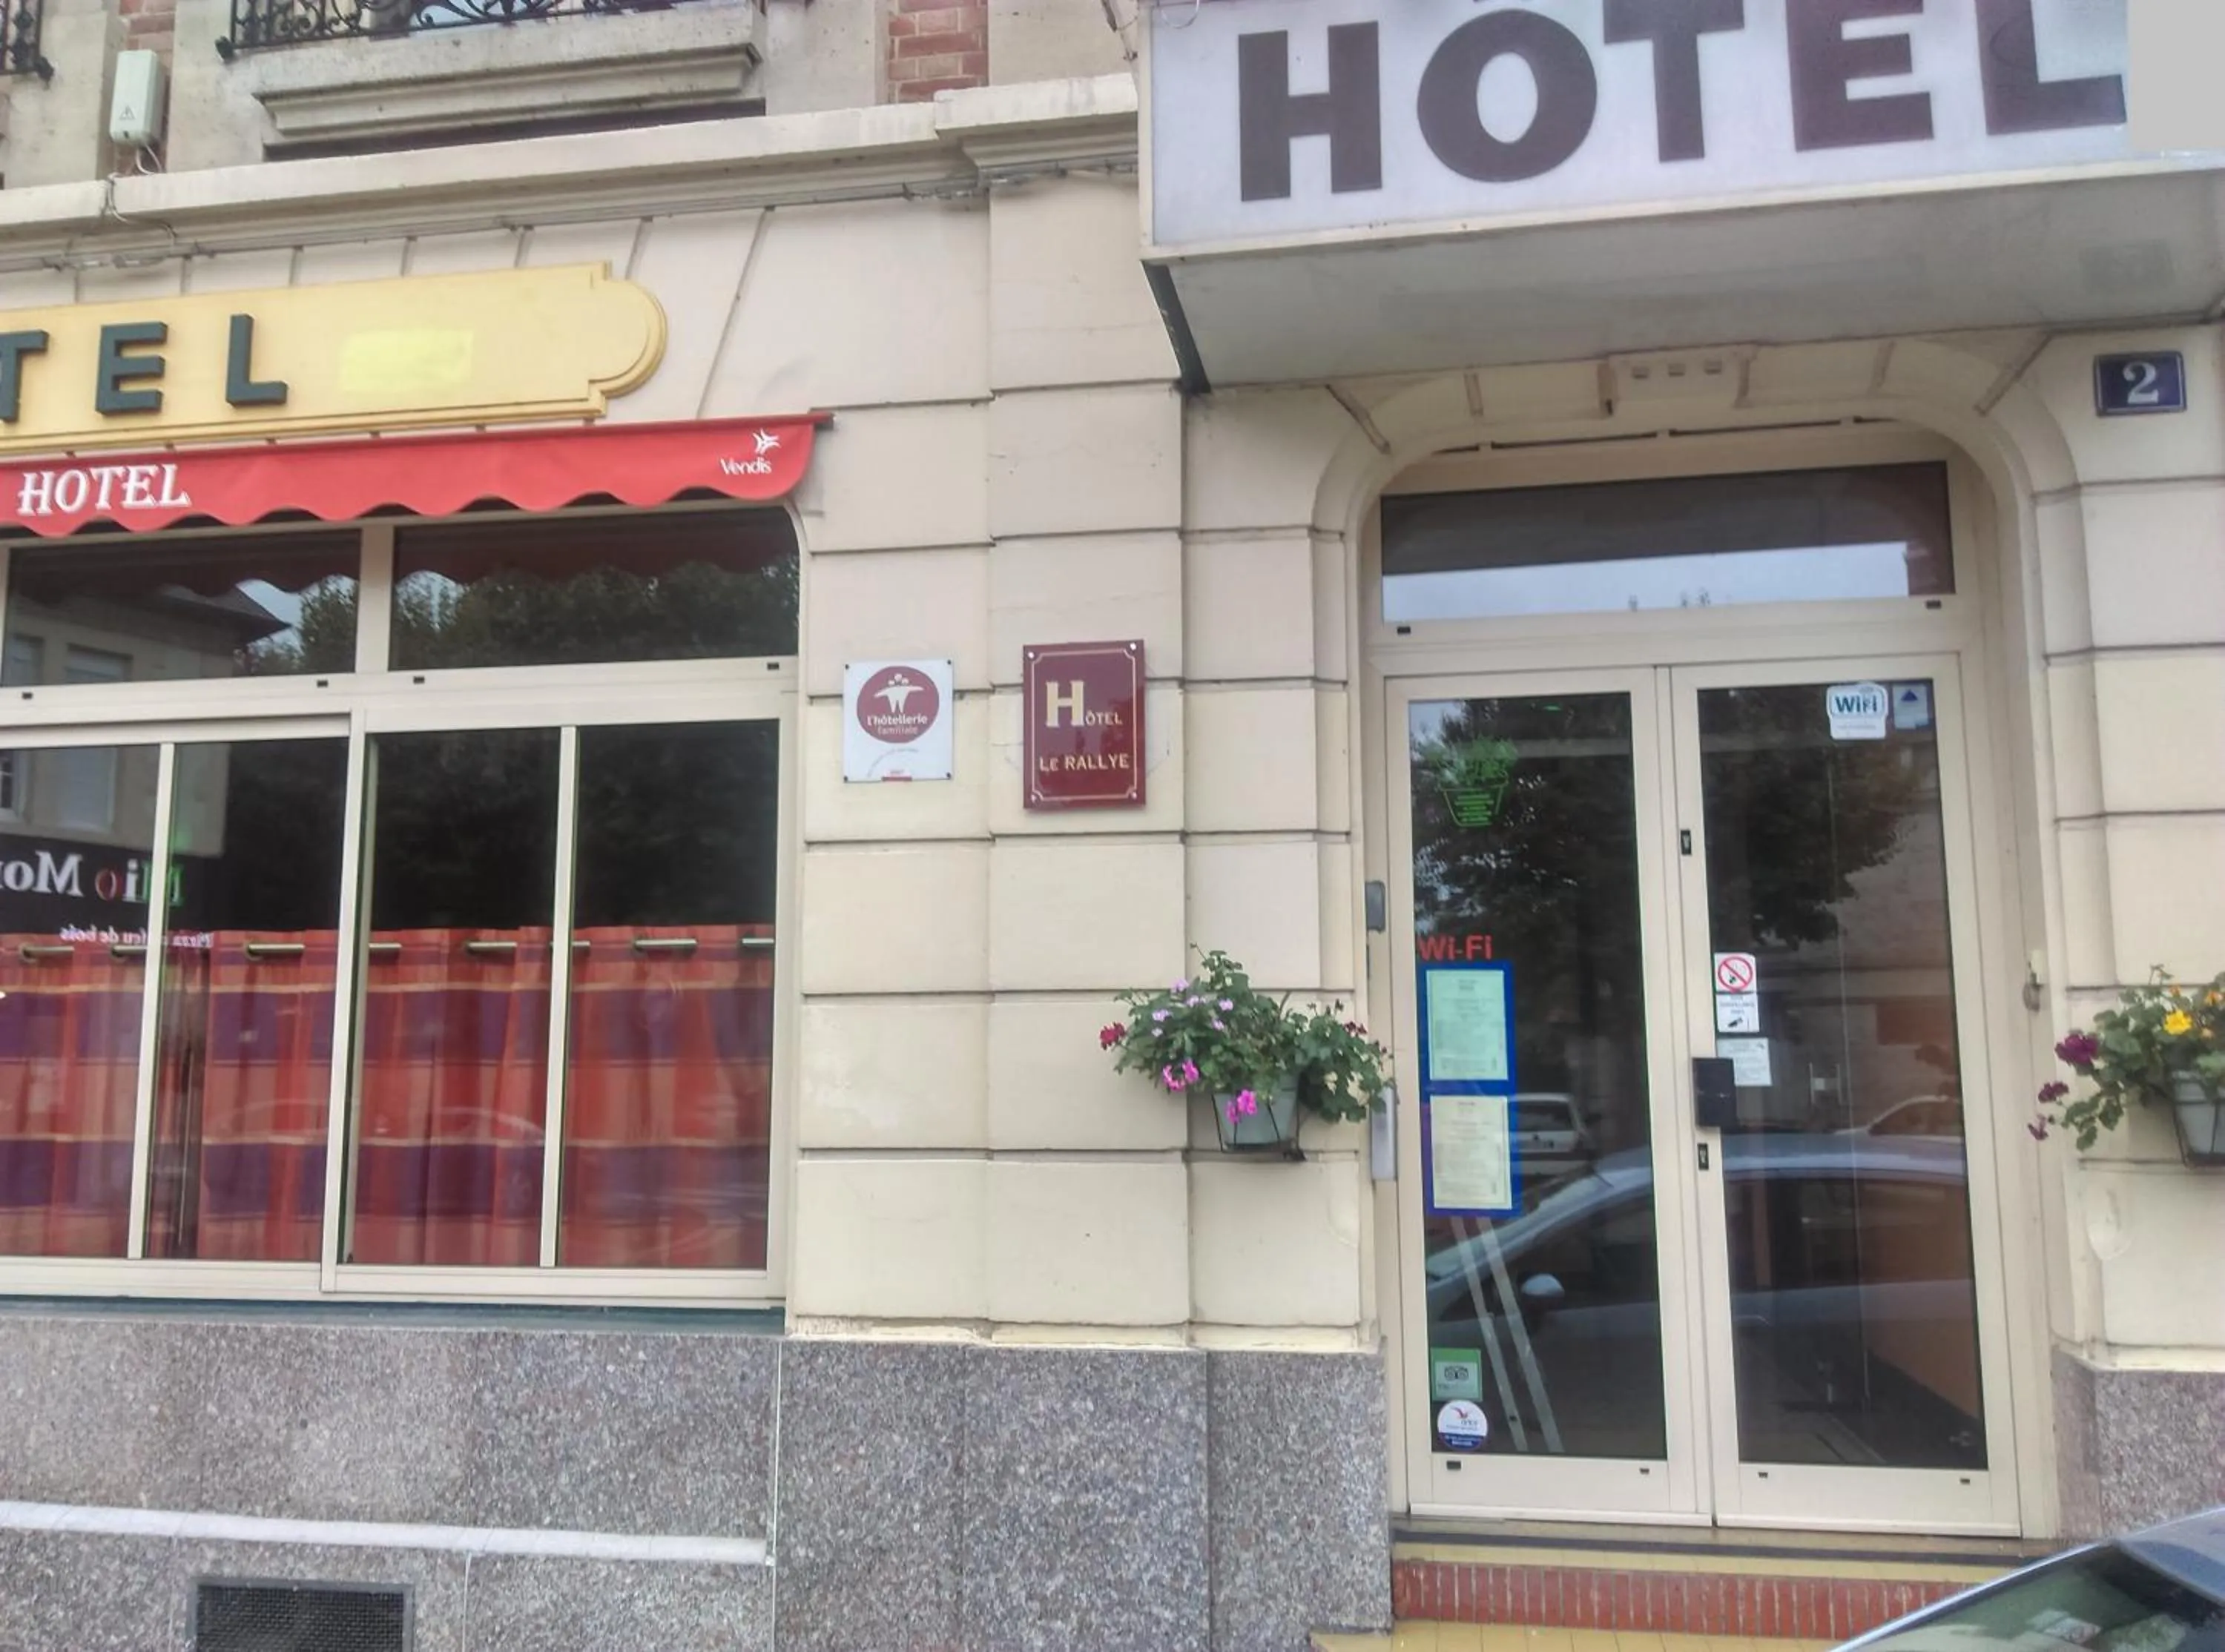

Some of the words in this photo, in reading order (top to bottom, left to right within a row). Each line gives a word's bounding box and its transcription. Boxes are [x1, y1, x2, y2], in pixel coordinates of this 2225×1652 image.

[2123, 361, 2159, 405] 2
[720, 456, 772, 475] Vendis
[16, 463, 193, 517] HOTEL
[1065, 753, 1130, 771] RALLYE
